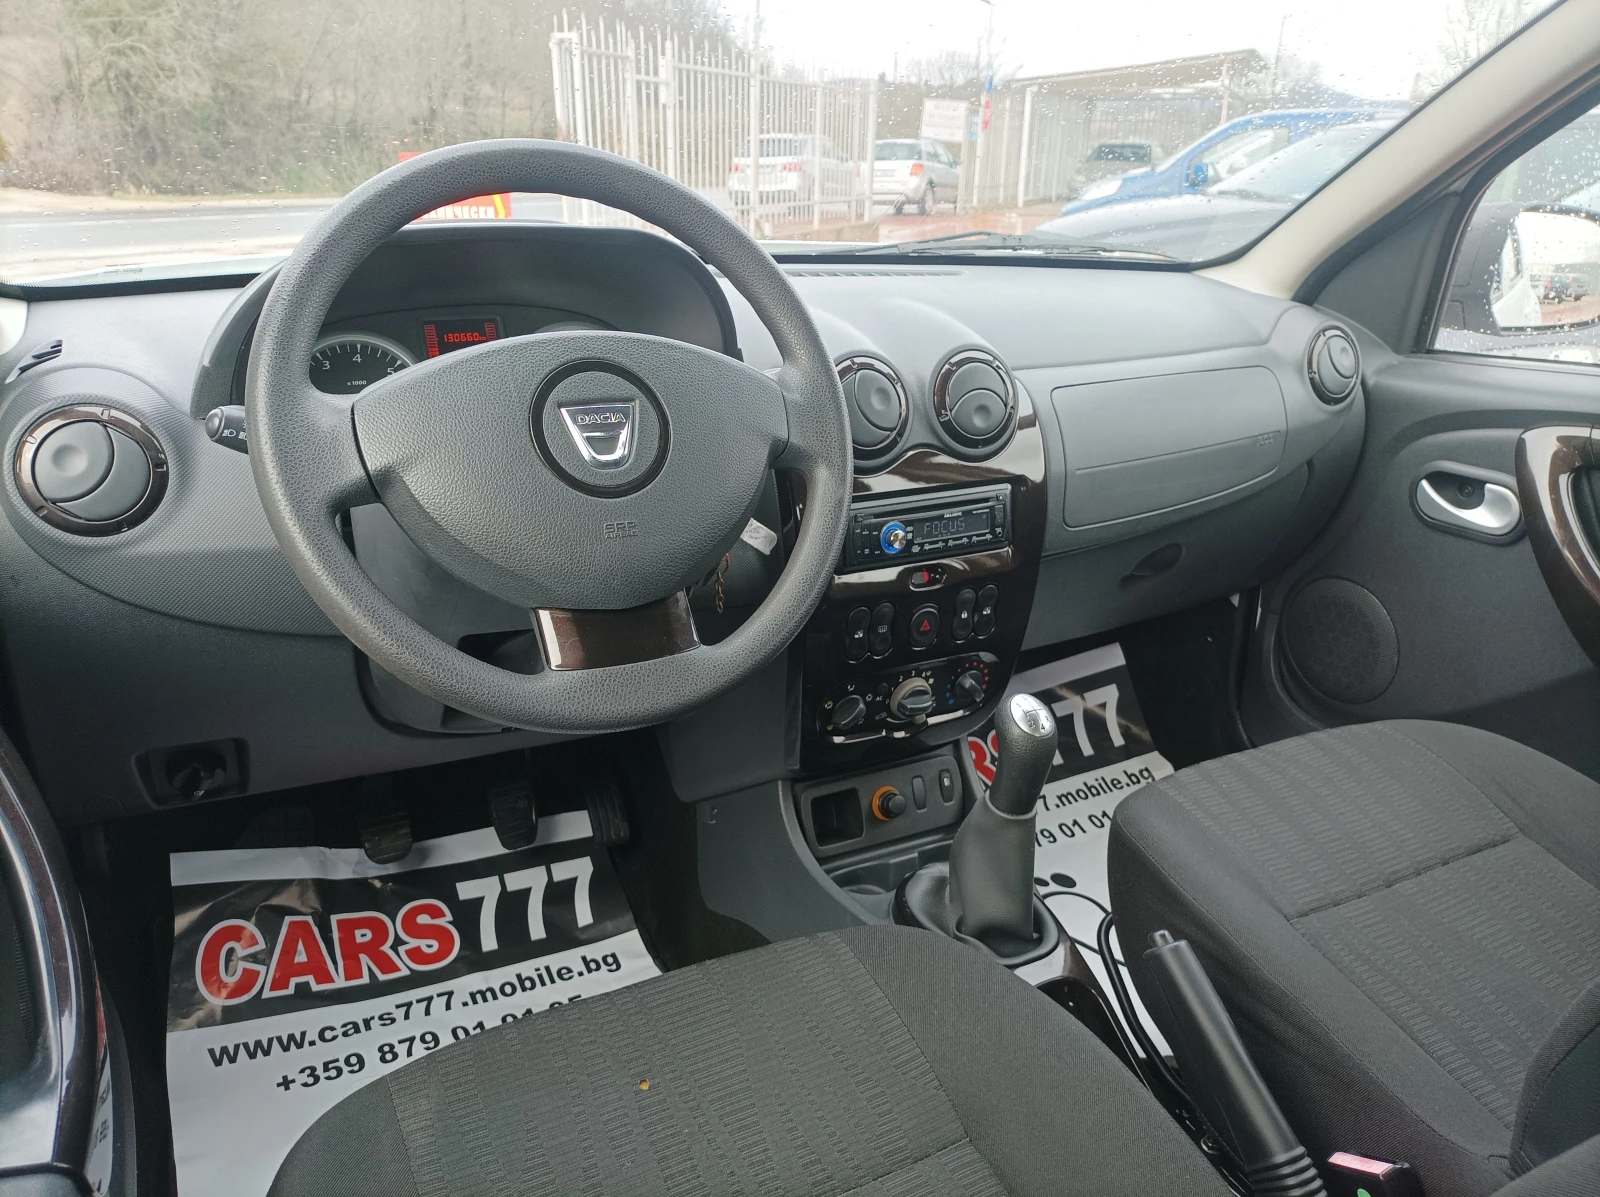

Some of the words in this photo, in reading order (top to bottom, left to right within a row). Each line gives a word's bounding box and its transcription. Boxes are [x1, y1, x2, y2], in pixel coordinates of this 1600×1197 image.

[322, 360, 331, 370] 3
[352, 353, 362, 363] 4
[575, 411, 627, 425] DACIA
[924, 518, 965, 535] FOCUS
[1058, 818, 1087, 839] 01
[196, 898, 461, 1006] CARS
[455, 856, 594, 953] 777
[207, 952, 622, 1068] www.cars777.mobile.bg
[276, 1052, 366, 1092] +359
[377, 1031, 441, 1065] 879
